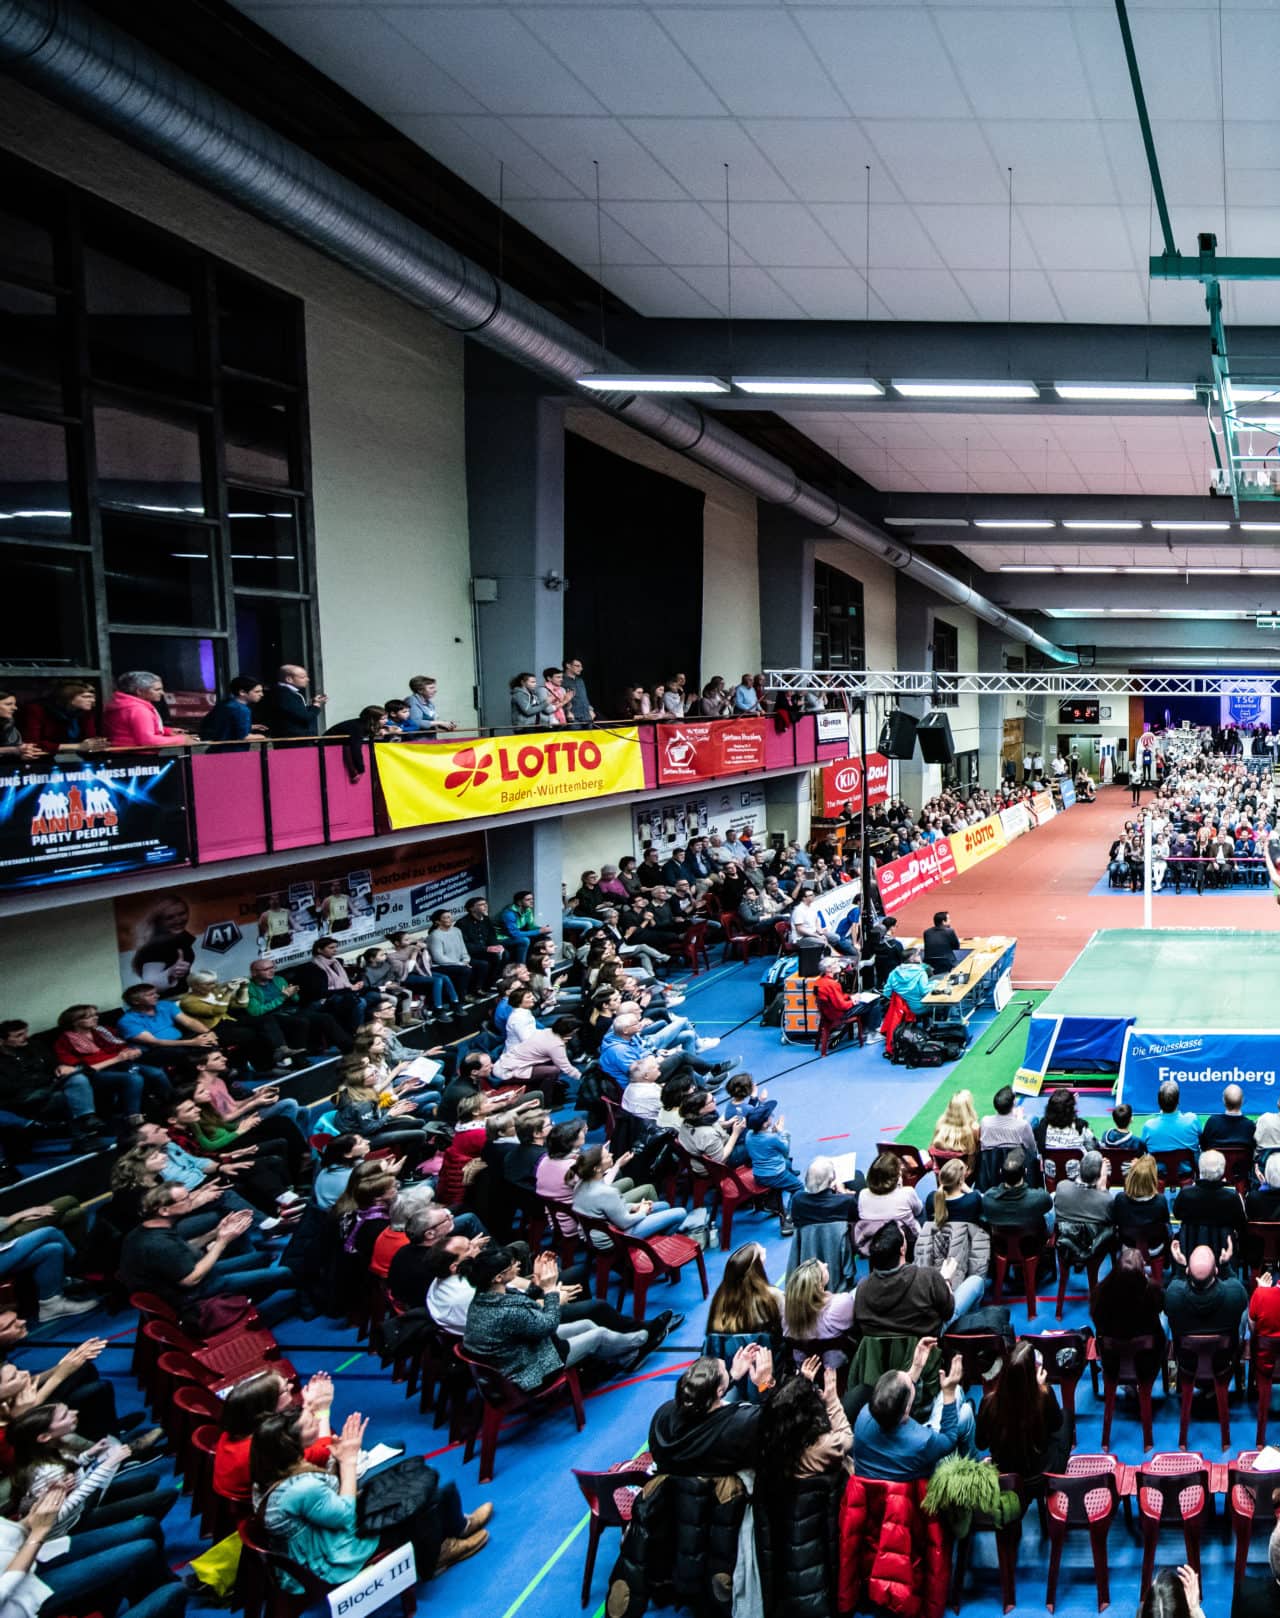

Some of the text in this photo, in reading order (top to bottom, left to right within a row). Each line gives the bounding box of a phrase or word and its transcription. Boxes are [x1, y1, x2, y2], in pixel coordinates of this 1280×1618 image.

[499, 740, 601, 781] LOTTO
[500, 778, 604, 803] Baden-Württemberg
[31, 811, 118, 835] ANDY'S
[32, 831, 73, 847] PARTY
[76, 826, 120, 840] PEOPLE
[972, 824, 995, 846] LOTTO
[210, 925, 233, 945] A1
[1132, 1038, 1203, 1056] Die Fitnesskasse
[1158, 1067, 1276, 1086] Freudenberg
[337, 1558, 411, 1615] Block III
